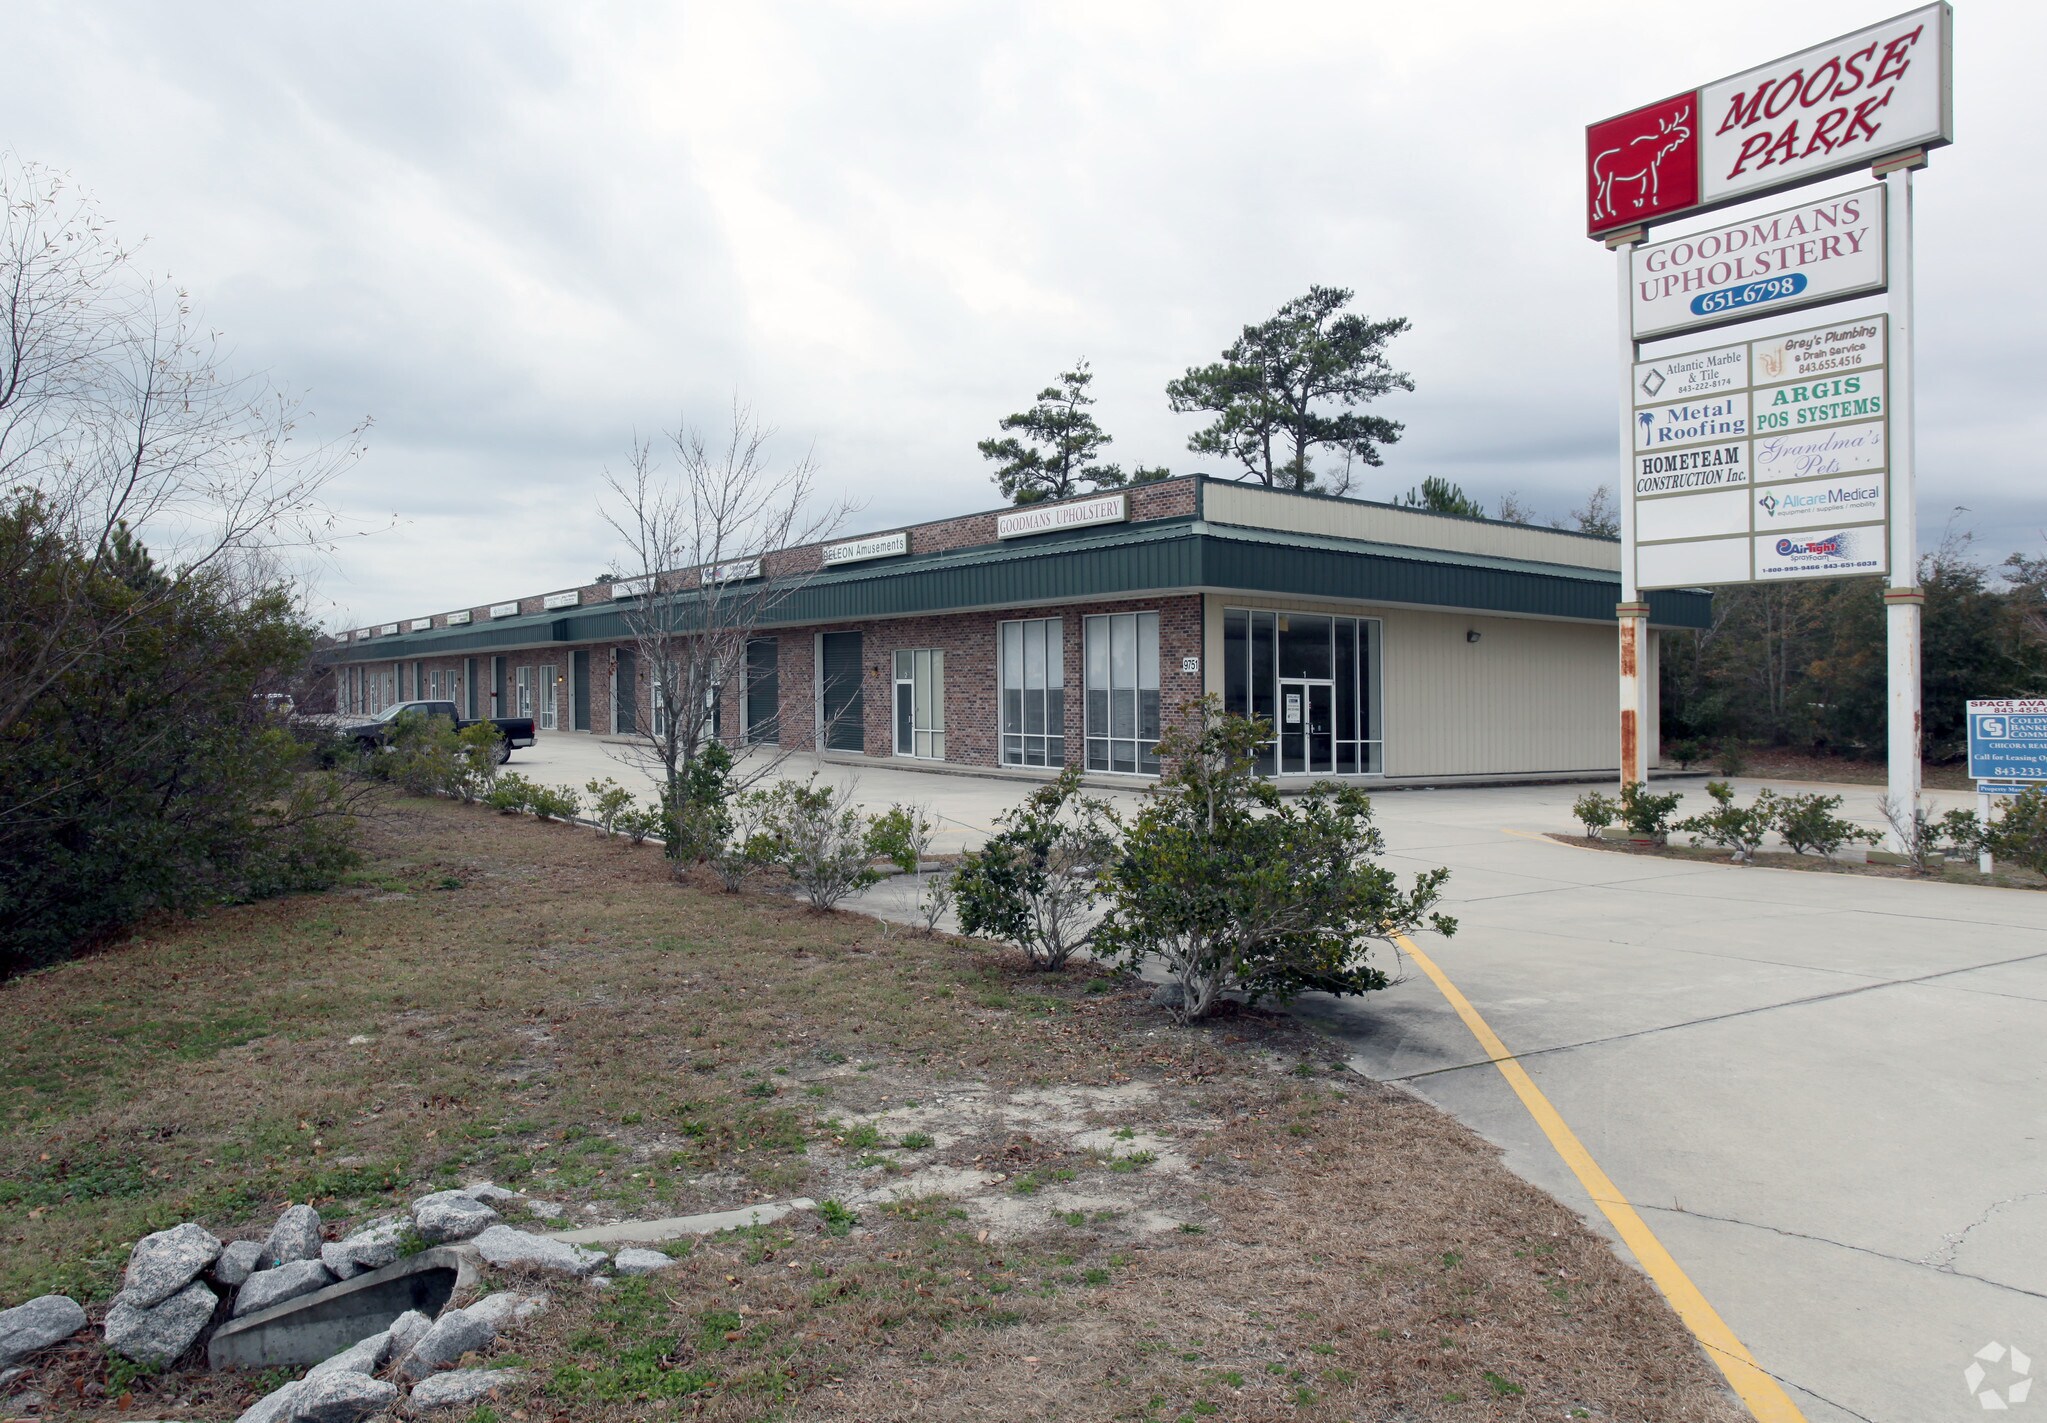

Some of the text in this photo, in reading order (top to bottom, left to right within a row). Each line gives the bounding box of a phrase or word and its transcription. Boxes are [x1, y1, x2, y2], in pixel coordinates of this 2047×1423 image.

[1715, 24, 1924, 136] MOOSE
[1726, 86, 1895, 180] PARK
[1645, 198, 1861, 273] GOODMANS
[1639, 227, 1870, 302] UPHOLSTERY
[1701, 277, 1794, 312] 651-6798
[1785, 326, 1877, 351] Grey's Plumbing
[1666, 352, 1742, 375] Atlantic Marble
[1798, 354, 1862, 374] 843.655.4516
[1803, 350, 1827, 361] Drain
[1829, 343, 1866, 356] Service
[1678, 378, 1732, 394] 843-222-8174
[1688, 369, 1720, 383] & Tile
[1771, 376, 1861, 406] ARGIS
[1667, 400, 1733, 424] Metal
[1757, 396, 1881, 430] POS SYSTEMS
[1658, 419, 1746, 442] Roofing
[1758, 430, 1881, 464] Grandma's
[1642, 446, 1740, 475] HOMETEAM
[1794, 454, 1841, 478] Pets
[1637, 468, 1747, 493] CONSTRUCTION Inc.
[1000, 500, 1120, 533] GOODMANS UPHOLSTERY
[1777, 508, 1811, 516] equipment
[856, 538, 904, 556] Amusements
[1183, 660, 1198, 670] 9751
[2006, 755, 2037, 763] Leasing
